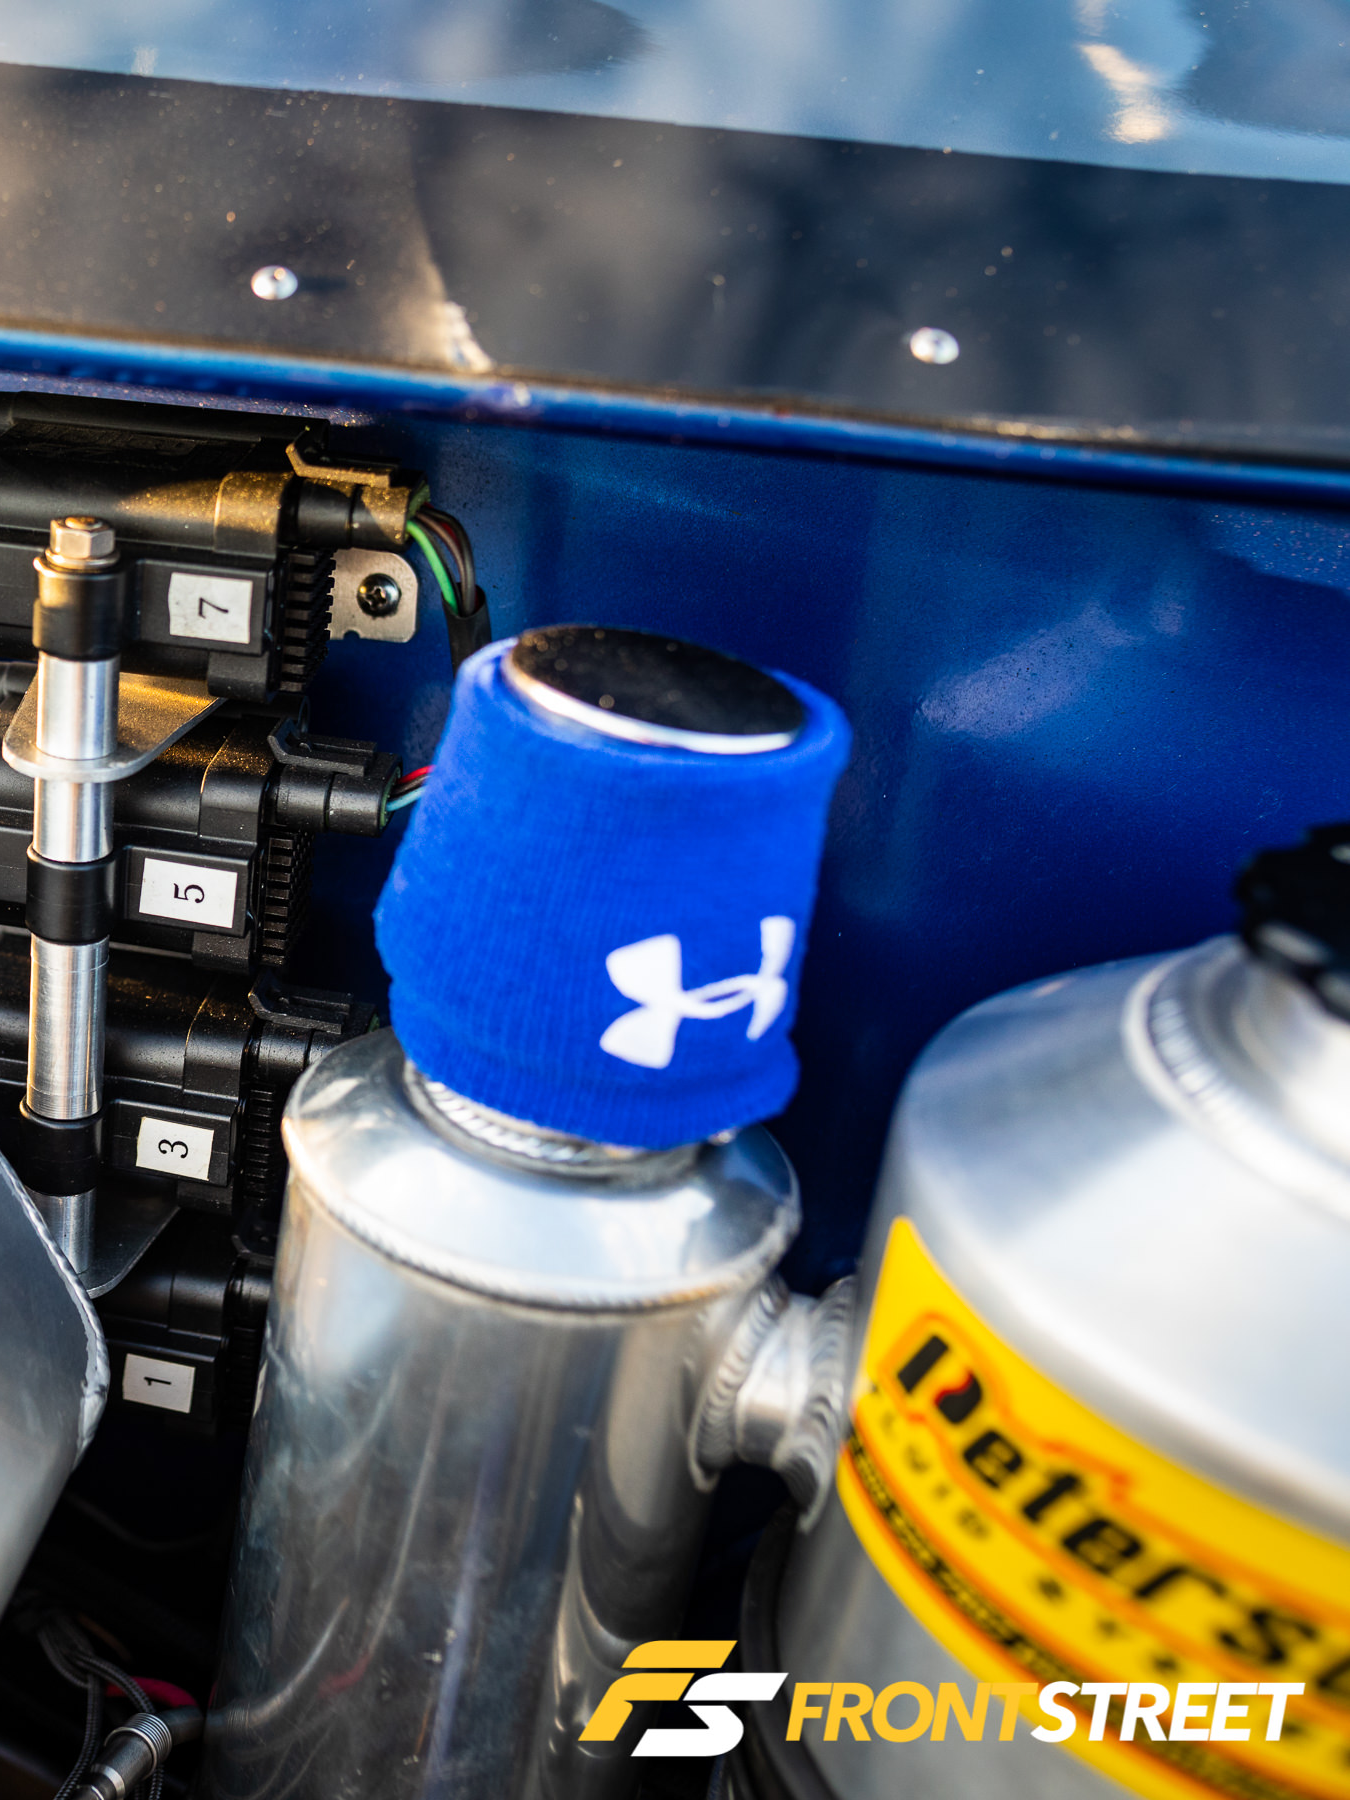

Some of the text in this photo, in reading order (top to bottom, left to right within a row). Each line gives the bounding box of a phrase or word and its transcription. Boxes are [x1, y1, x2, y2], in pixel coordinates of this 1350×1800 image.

[197, 596, 230, 619] 7
[173, 882, 206, 904] 5
[157, 1138, 189, 1159] 3
[143, 1375, 172, 1387] 1
